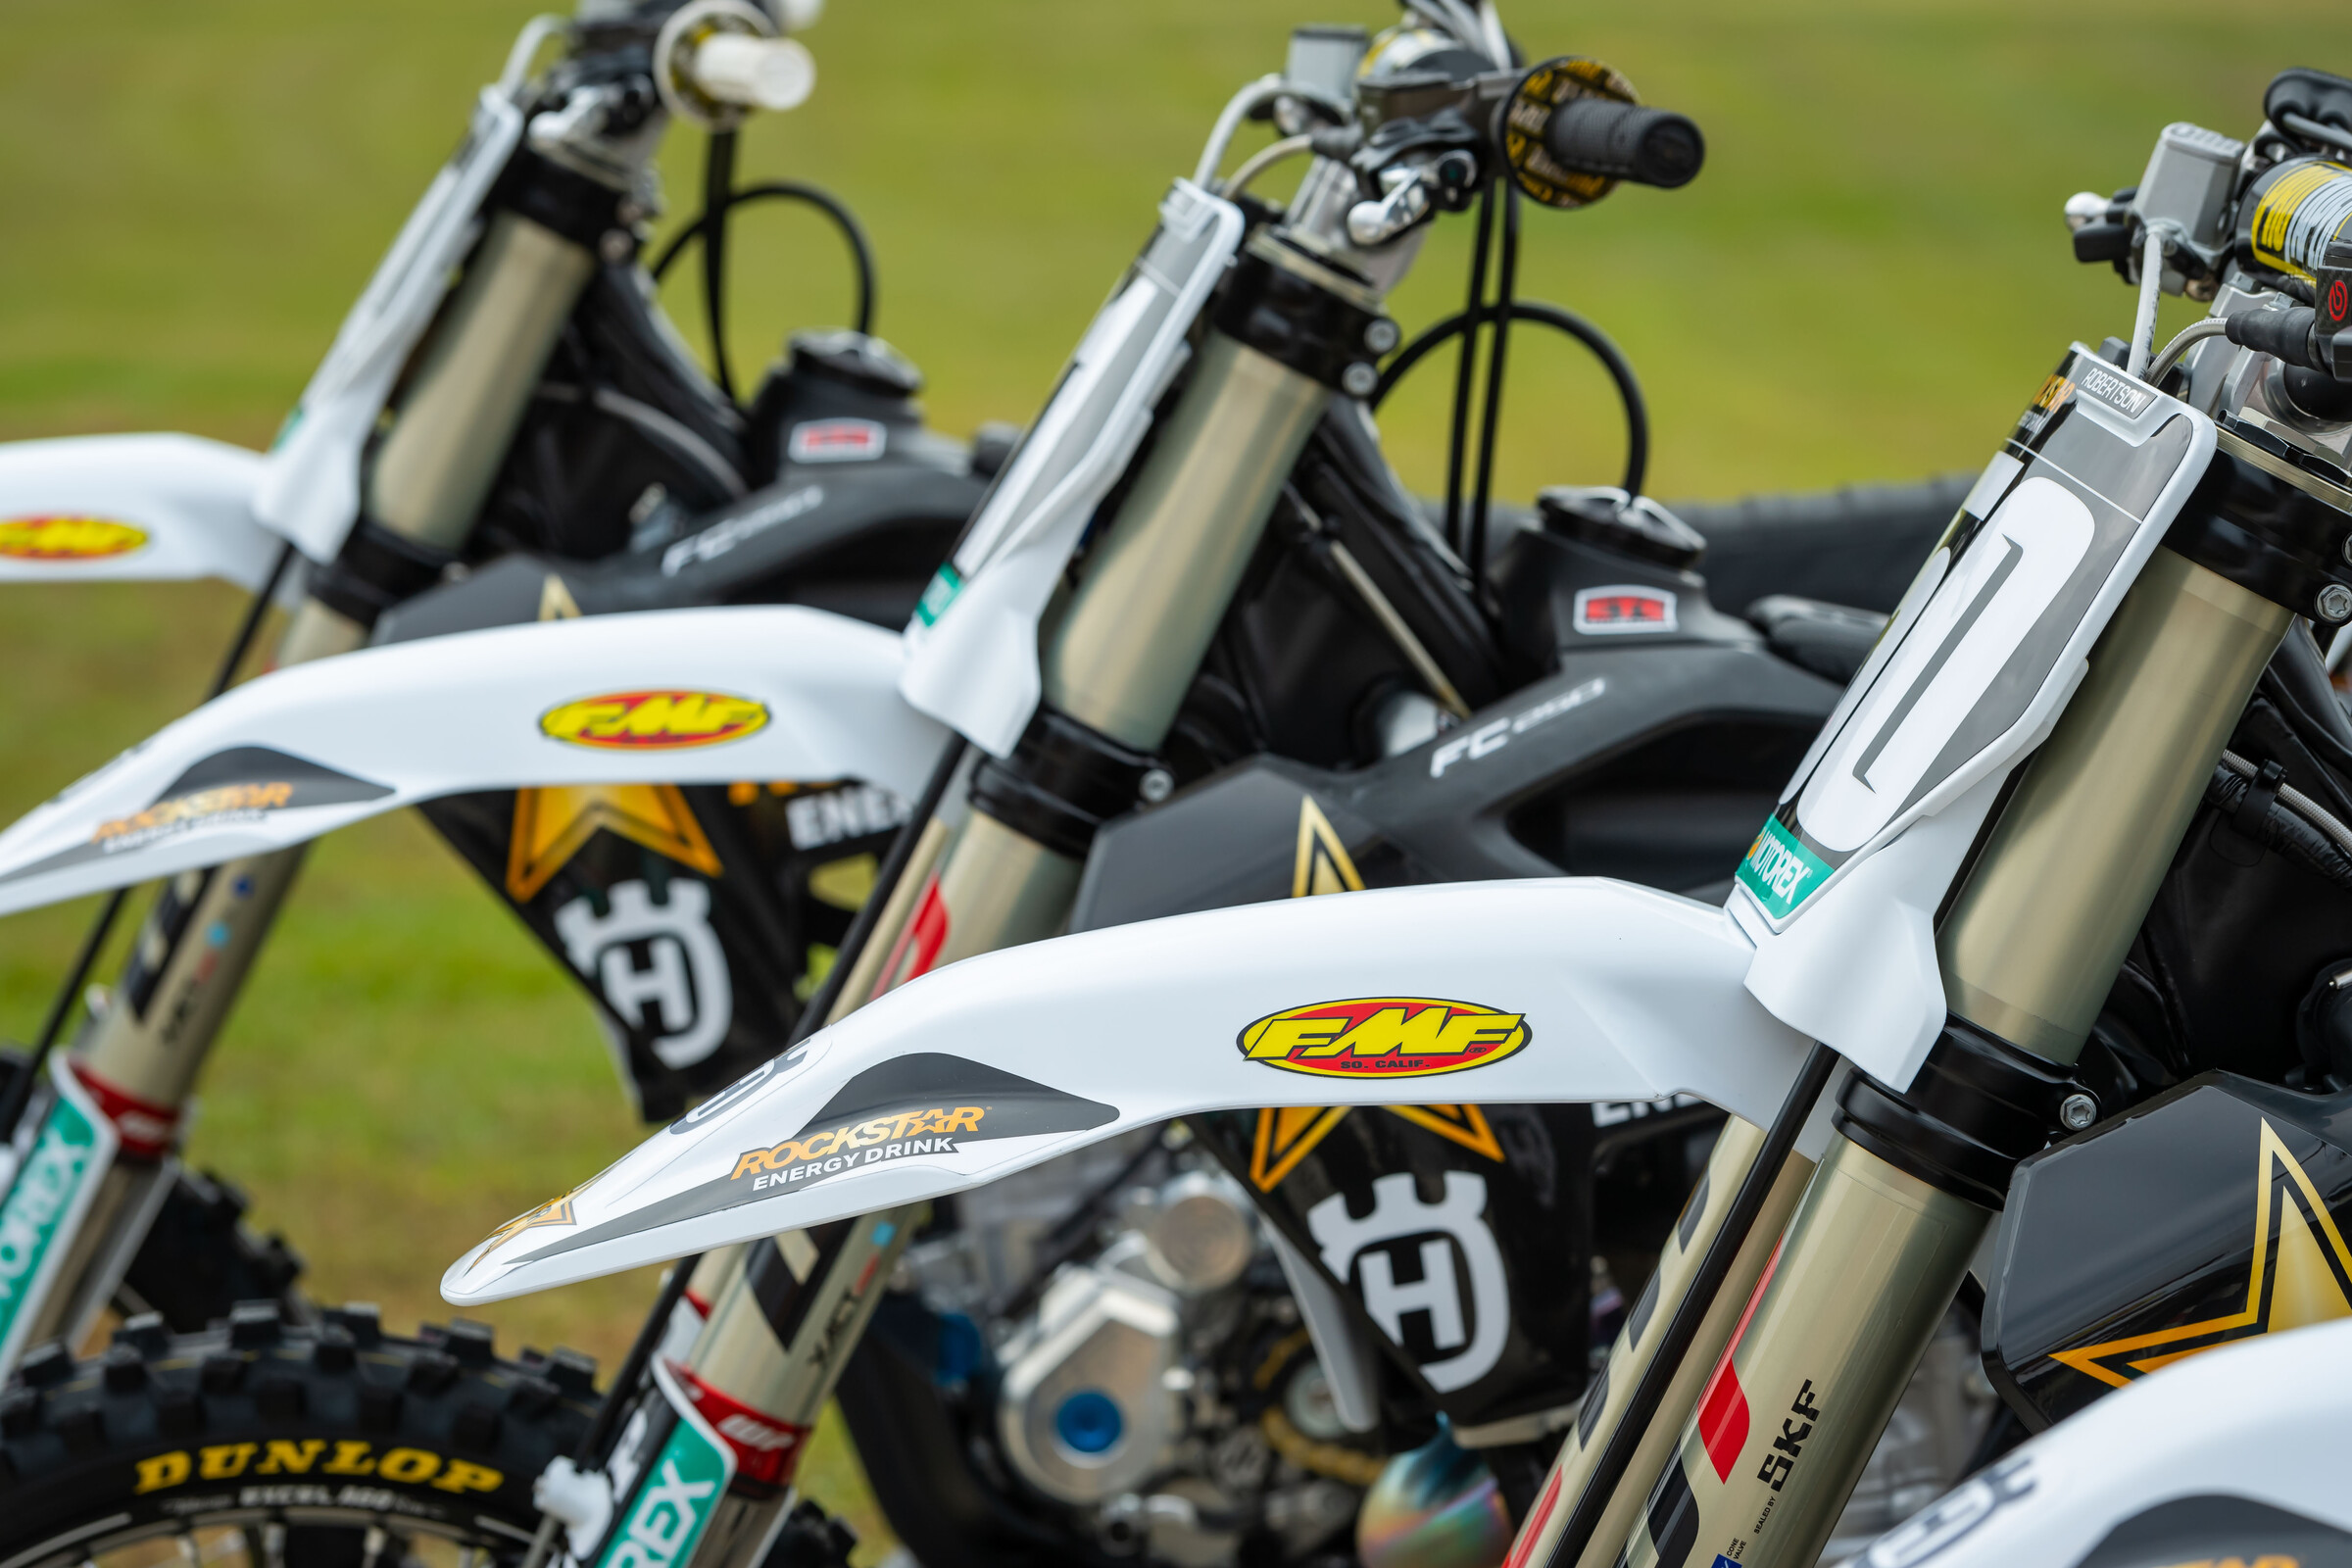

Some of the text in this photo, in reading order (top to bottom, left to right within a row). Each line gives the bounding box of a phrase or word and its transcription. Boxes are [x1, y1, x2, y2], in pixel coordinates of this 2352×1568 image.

[2081, 368, 2147, 414] ROBERTSON
[541, 691, 768, 738] FMF
[1429, 716, 1511, 779] FC
[1242, 1004, 1527, 1062] FMF
[1340, 1059, 1431, 1070] SO. CALIF.
[729, 1105, 985, 1181] ROCKSTAR
[752, 1137, 954, 1192] ENERGY DRINK
[1756, 1378, 1821, 1493] SKF
[133, 1439, 504, 1495] DUNLOP
[1753, 1495, 1777, 1535] SEALED BY
[1726, 1537, 1740, 1556] CONE
[1733, 1540, 1747, 1560] VALVE
